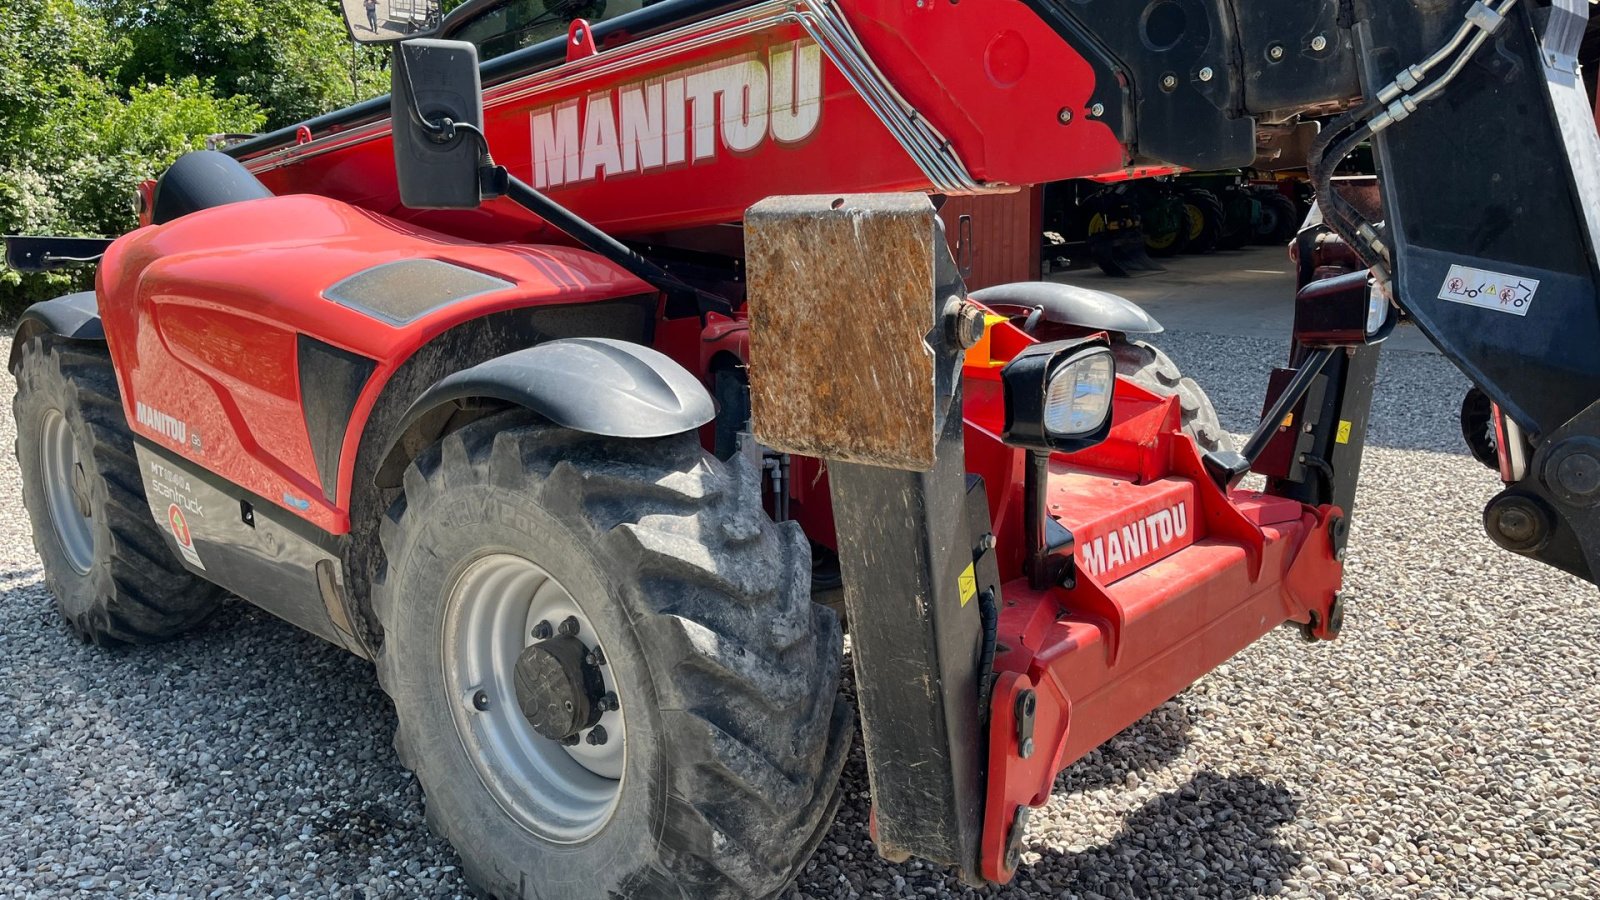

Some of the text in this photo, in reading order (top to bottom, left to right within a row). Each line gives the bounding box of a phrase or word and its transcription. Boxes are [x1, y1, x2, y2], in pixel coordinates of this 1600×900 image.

[530, 43, 822, 188] MANITOU
[137, 401, 186, 444] MANITOU
[152, 480, 204, 517] scantruck
[1082, 502, 1187, 576] MANITOU
